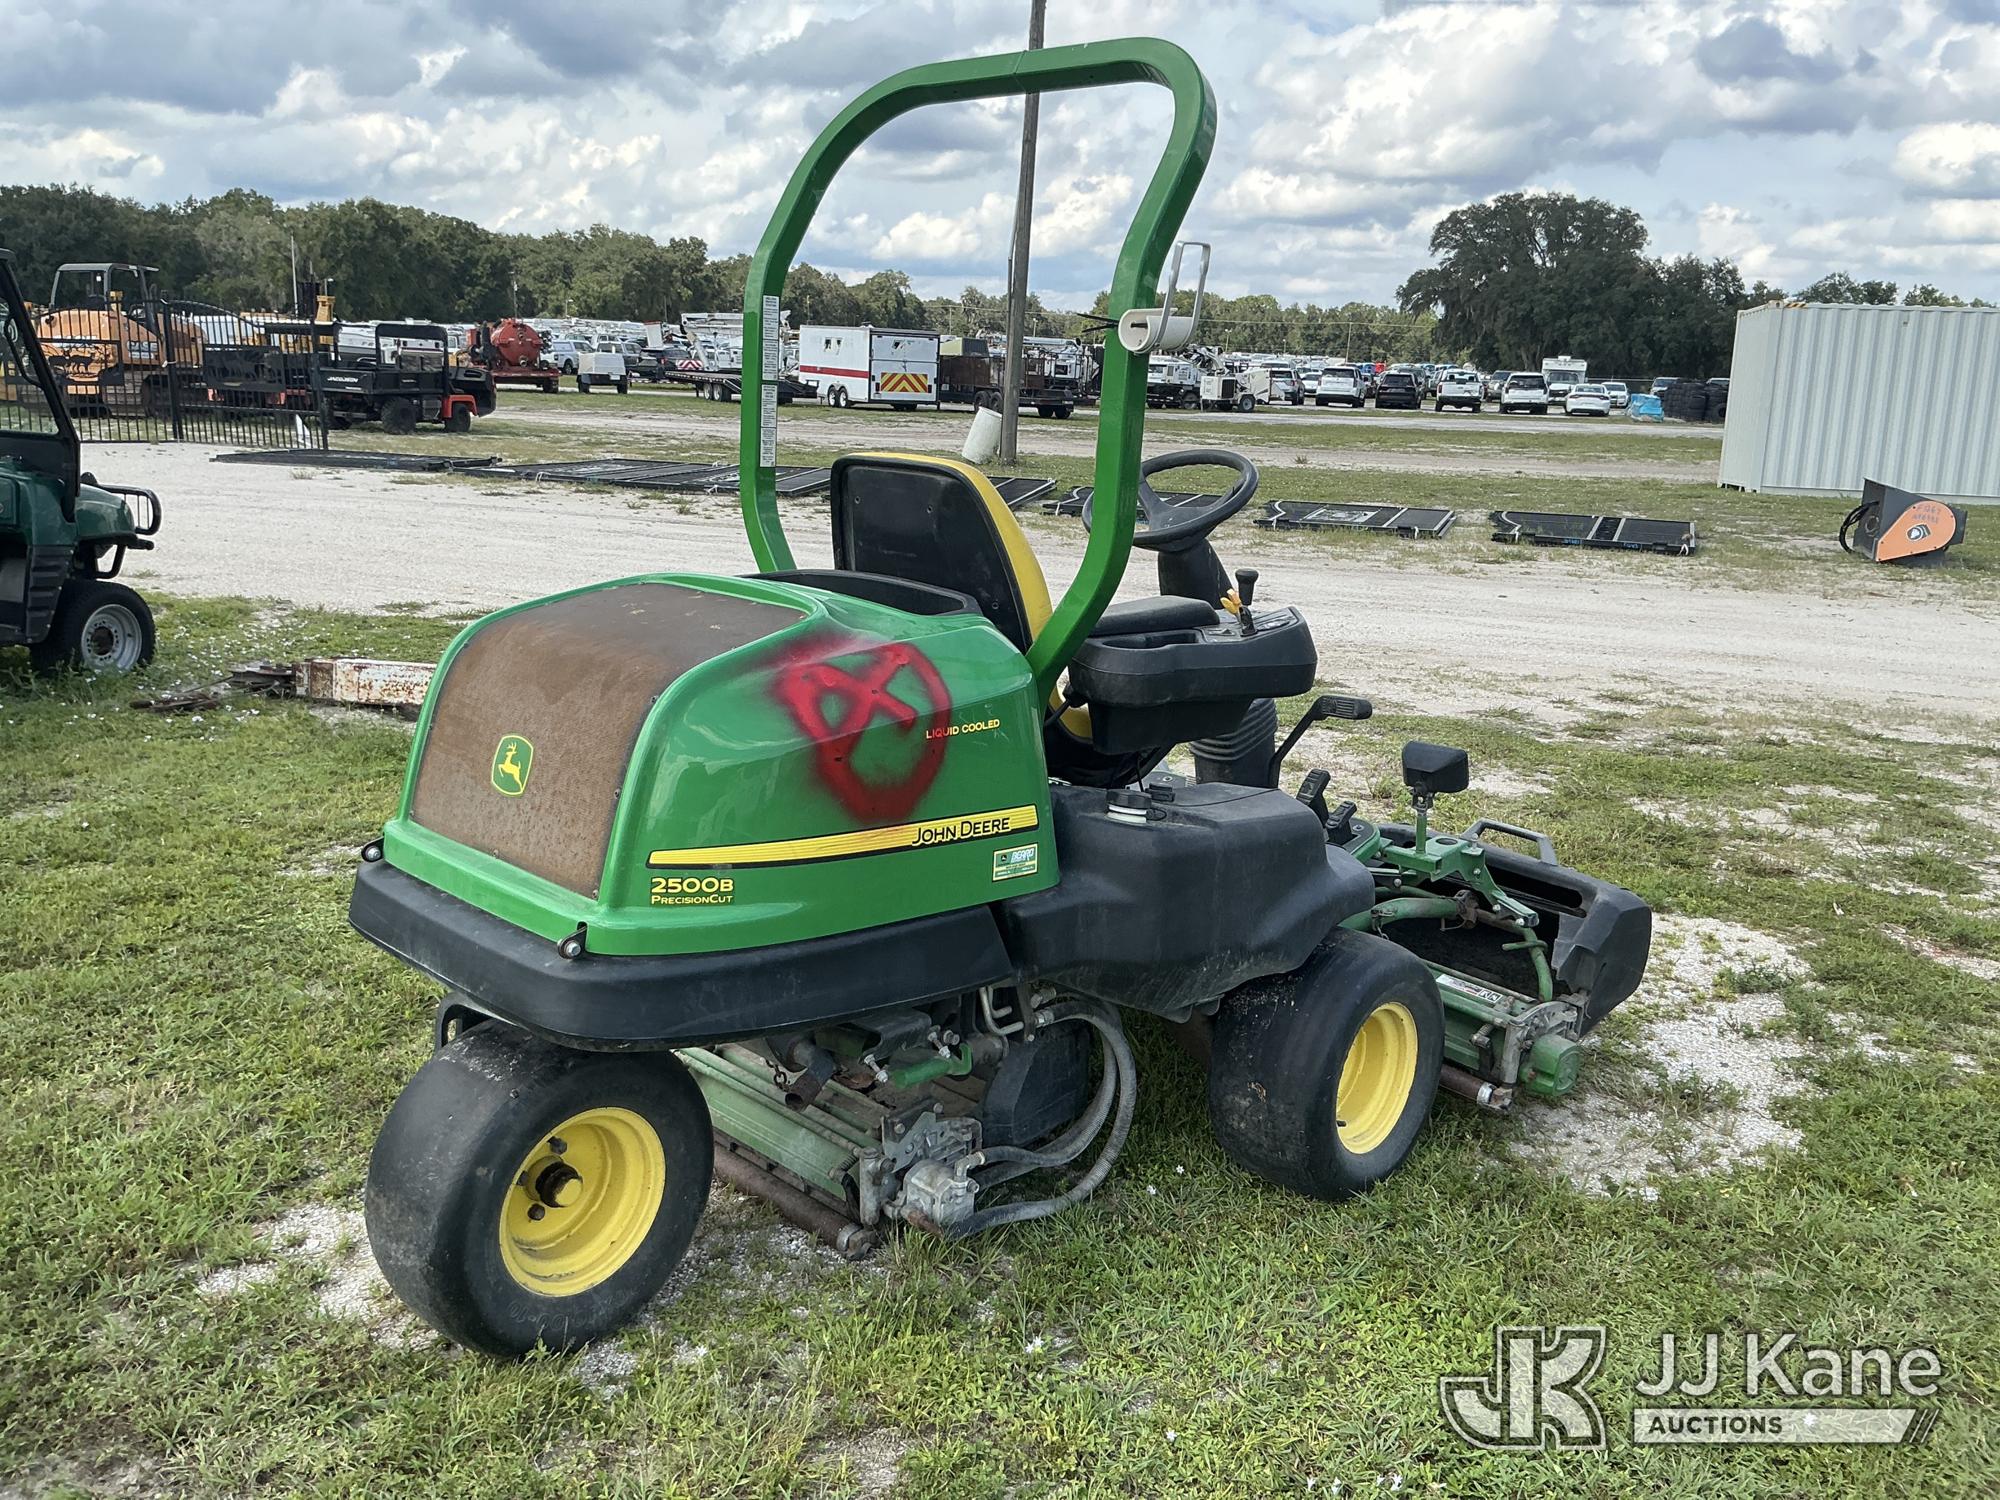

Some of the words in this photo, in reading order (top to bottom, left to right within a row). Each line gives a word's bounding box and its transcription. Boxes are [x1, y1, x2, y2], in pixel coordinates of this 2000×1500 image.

[926, 726, 959, 739] LIQUID
[961, 719, 1000, 733] COOLED
[912, 825, 956, 844] JOHN
[960, 817, 1010, 837] DEERE
[651, 877, 734, 893] 2500B
